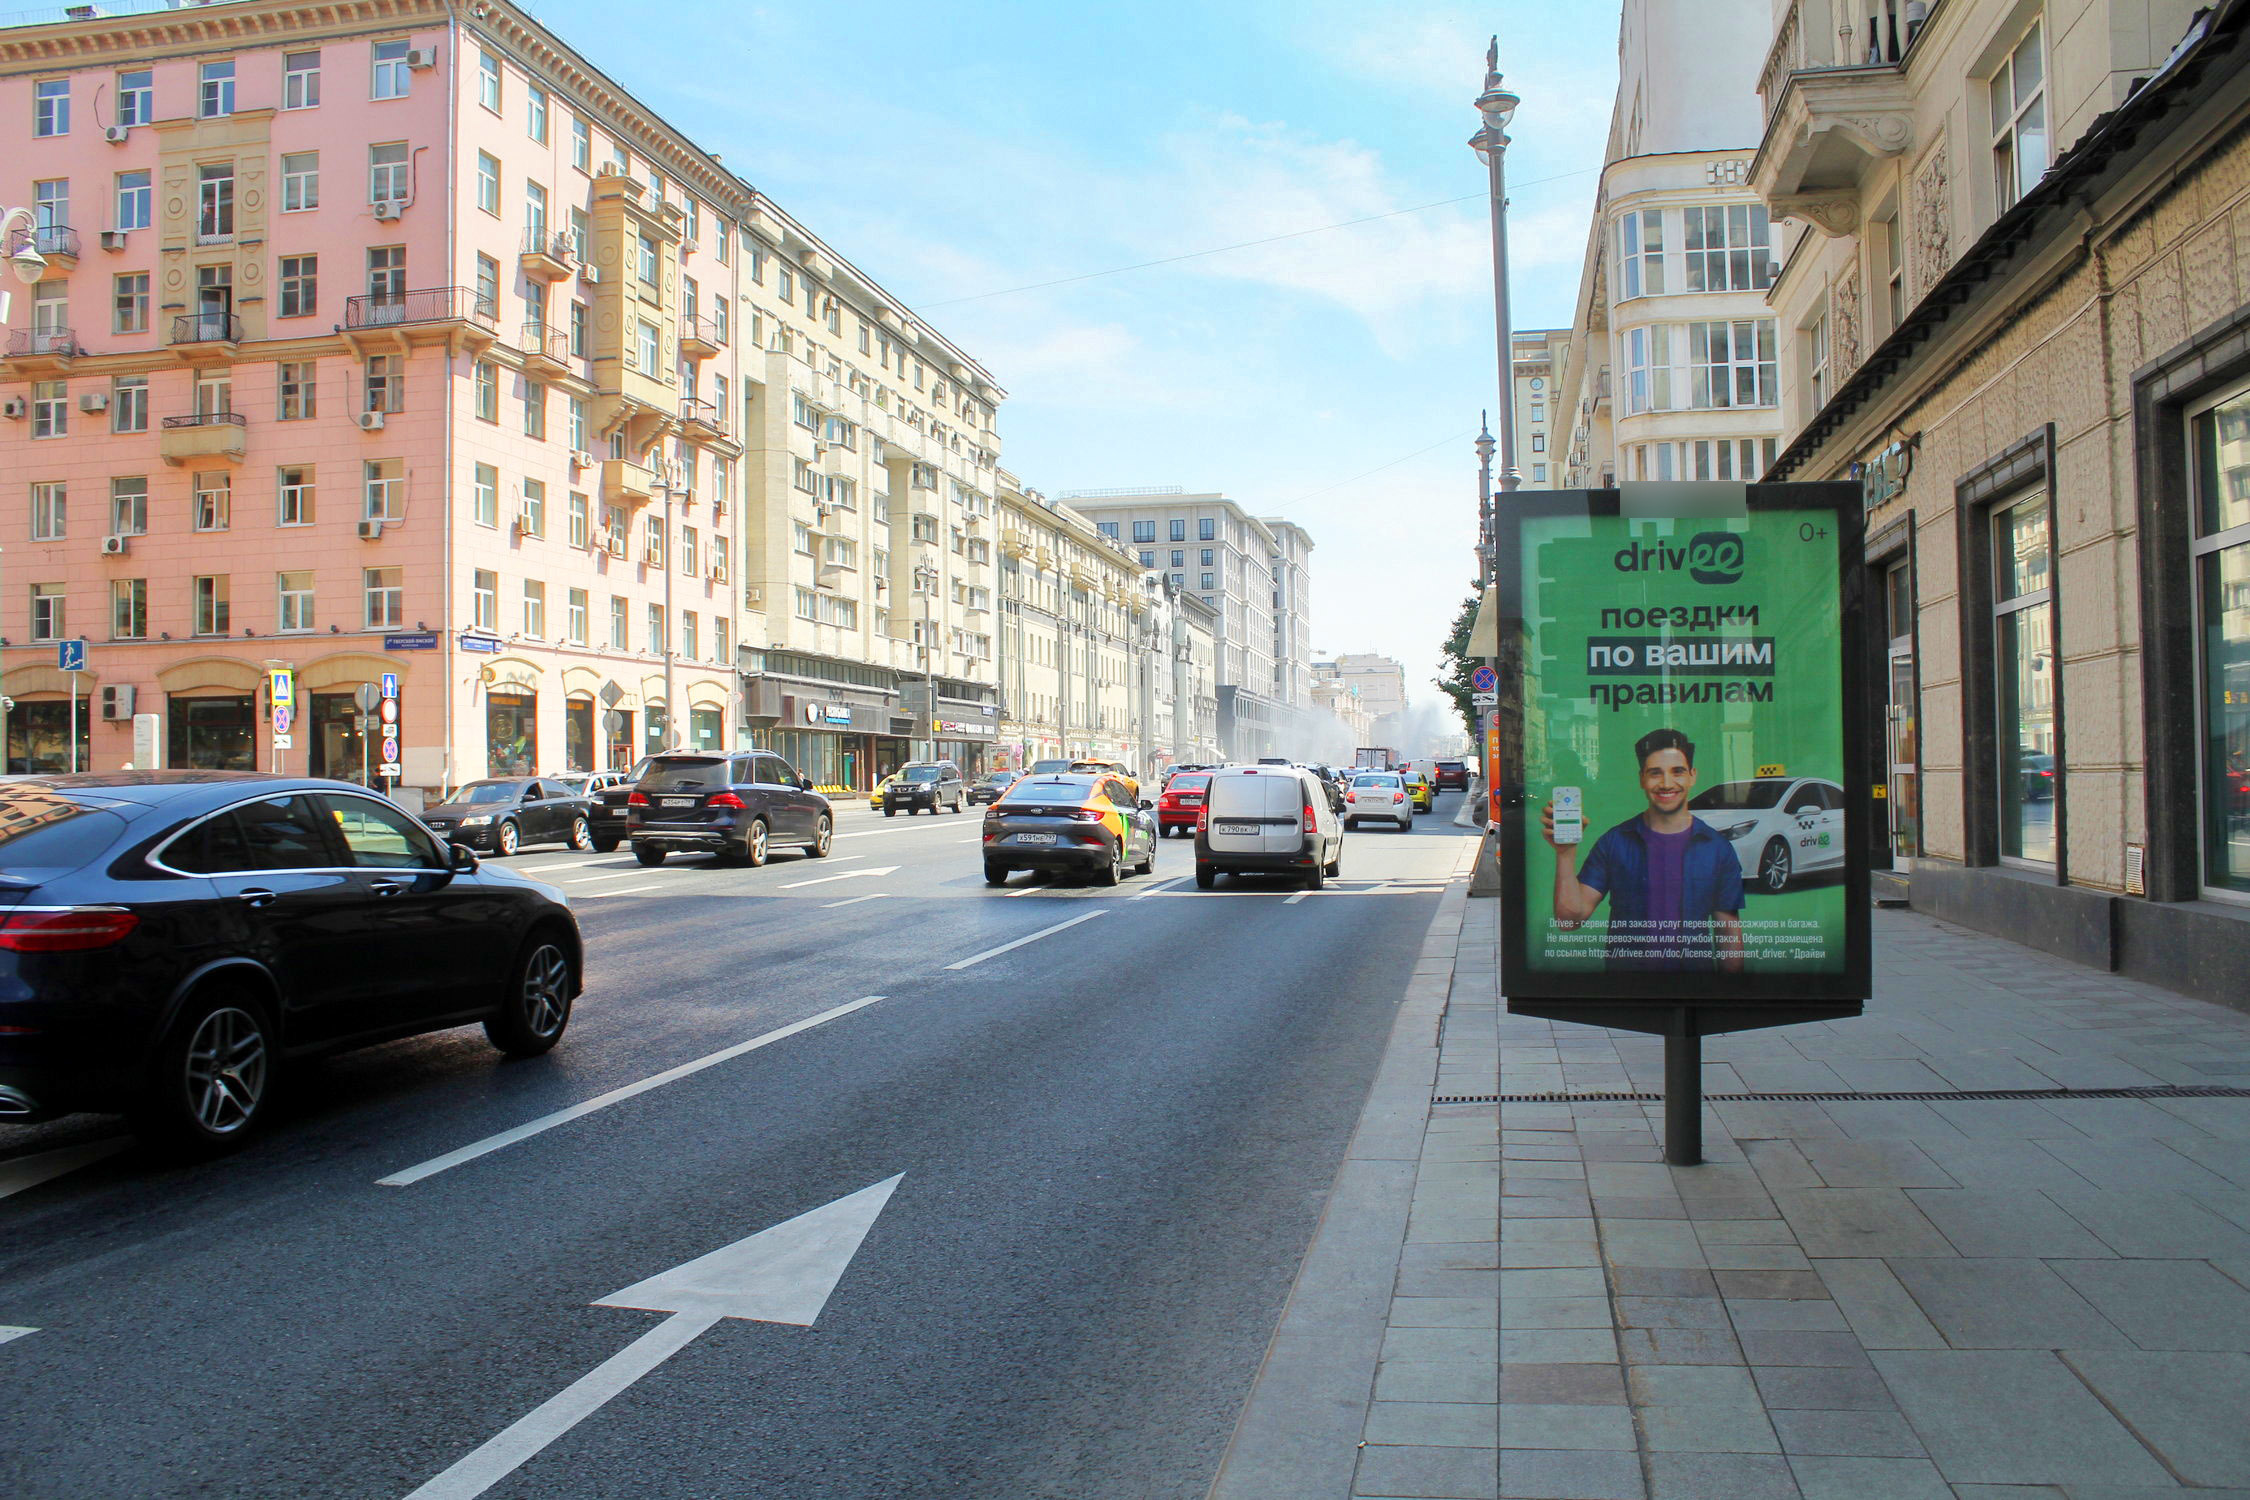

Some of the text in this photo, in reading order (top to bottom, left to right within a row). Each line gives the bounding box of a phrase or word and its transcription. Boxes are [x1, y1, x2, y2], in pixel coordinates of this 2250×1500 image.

[1799, 522, 1828, 542] 0+
[1614, 533, 1743, 583] drivee
[1601, 605, 1759, 632] поездки
[1590, 643, 1772, 667] по вашим
[1590, 681, 1773, 712] правилам
[1549, 918, 1574, 928] Drivee
[1581, 920, 1609, 930] сервис
[1611, 920, 1627, 929] для
[1629, 920, 1656, 928] заказа
[1658, 920, 1681, 930] услуг
[1683, 920, 1726, 930] перевозки
[1728, 920, 1779, 930] пассажиров
[1780, 920, 1785, 928] и
[1787, 918, 1820, 928] багажа.
[1546, 933, 1558, 943] Не
[1559, 935, 1597, 943] является
[1599, 935, 1657, 944] перевозчиком
[1659, 935, 1675, 943] или
[1676, 933, 1713, 944] службой
[1742, 933, 1773, 944] Оферта
[1775, 935, 1823, 945] размещена
[1544, 949, 1554, 957] по
[1556, 949, 1587, 957] ссылке
